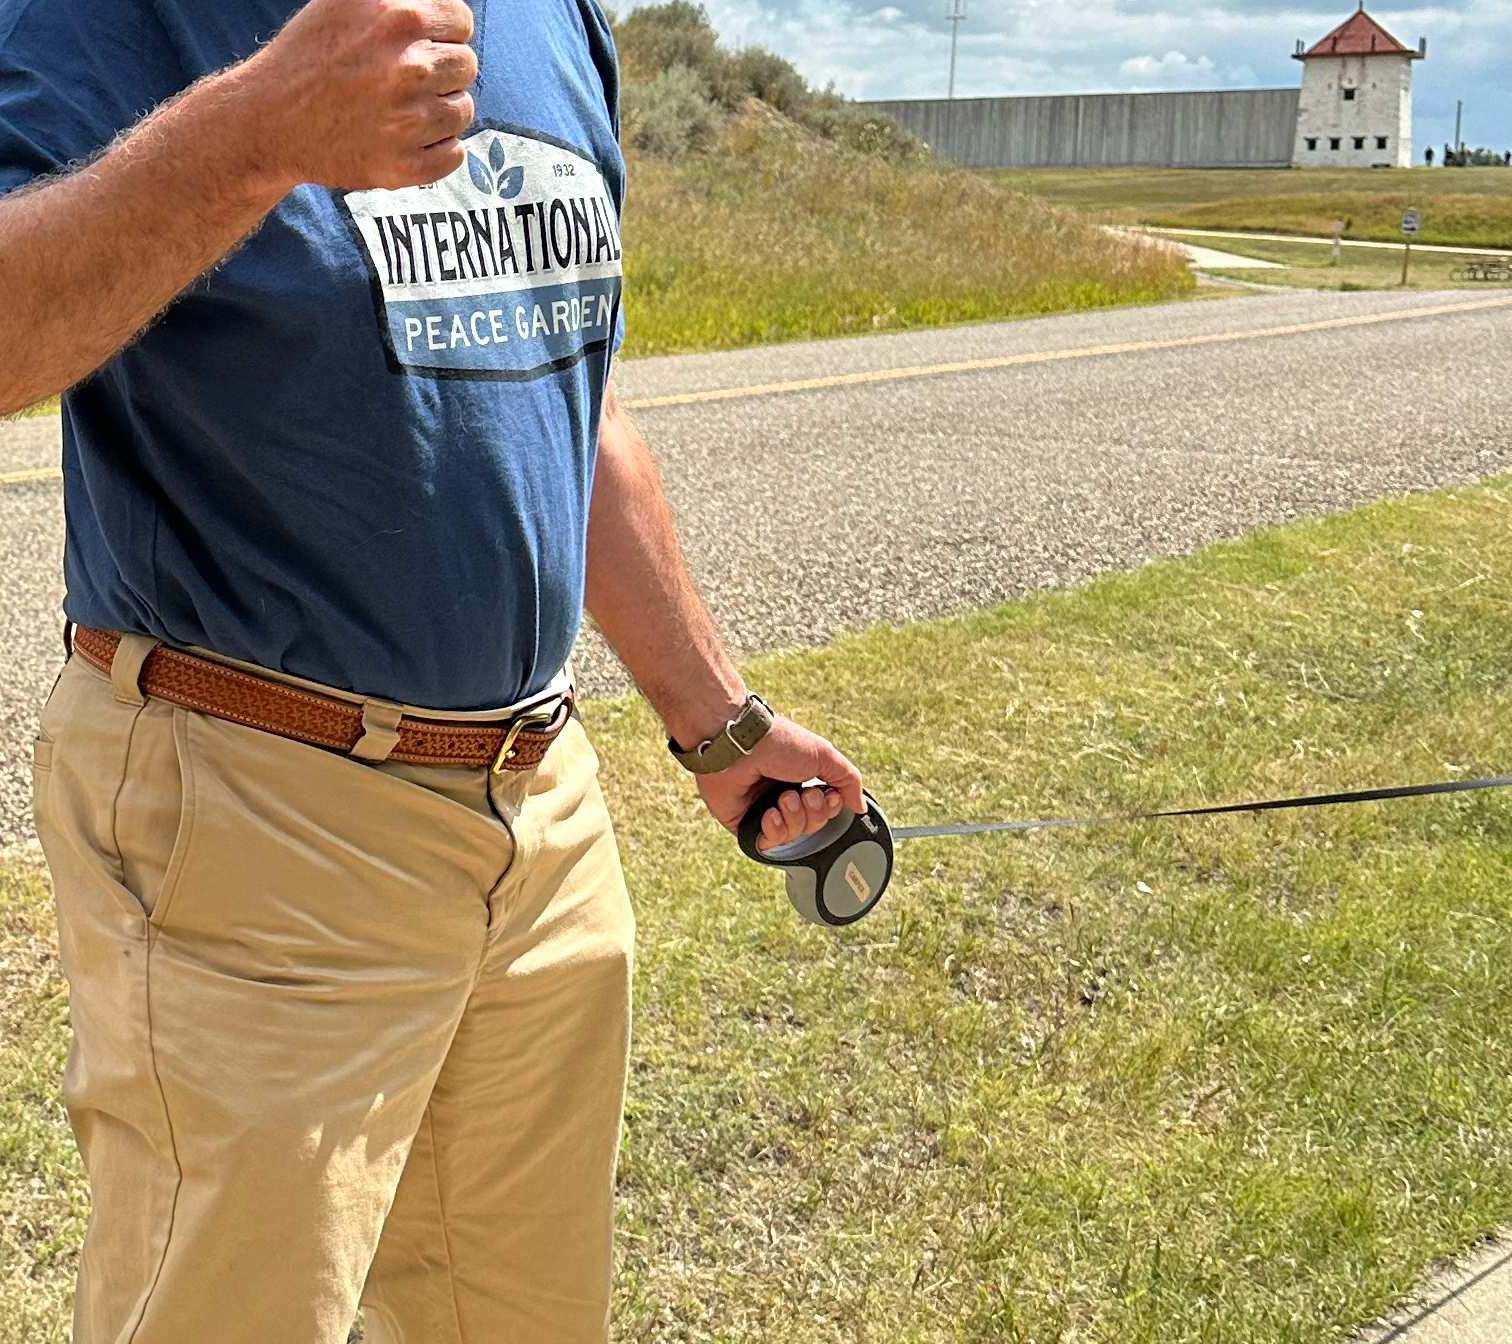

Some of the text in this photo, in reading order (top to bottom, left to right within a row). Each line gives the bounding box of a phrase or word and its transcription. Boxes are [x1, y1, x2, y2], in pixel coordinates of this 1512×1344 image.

[552, 163, 577, 177] 1932
[374, 197, 621, 285] INTERNATIONAL
[404, 292, 614, 352] PEACE GARDEN
